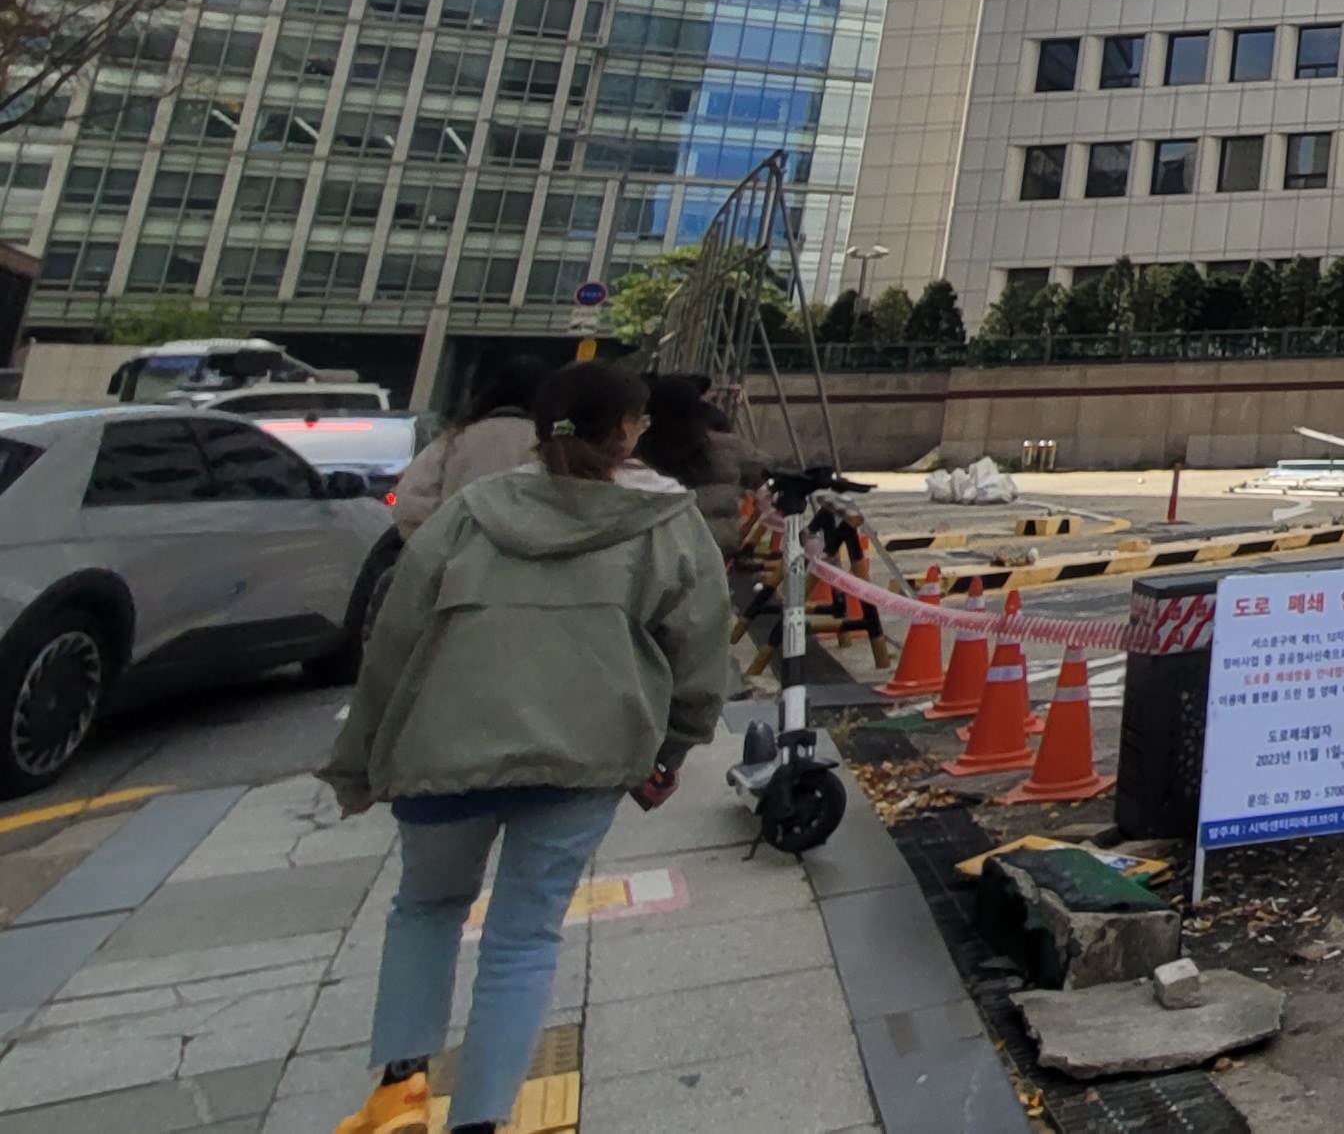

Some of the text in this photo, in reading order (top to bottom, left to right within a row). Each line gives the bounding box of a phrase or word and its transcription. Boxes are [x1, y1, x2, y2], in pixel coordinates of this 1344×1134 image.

[1232, 596, 1271, 617] 도로
[1288, 592, 1325, 614] 폐쇄
[1267, 724, 1332, 743] 도로폐쇄일자
[1256, 750, 1291, 767] 2023년
[1298, 747, 1319, 762] 11월
